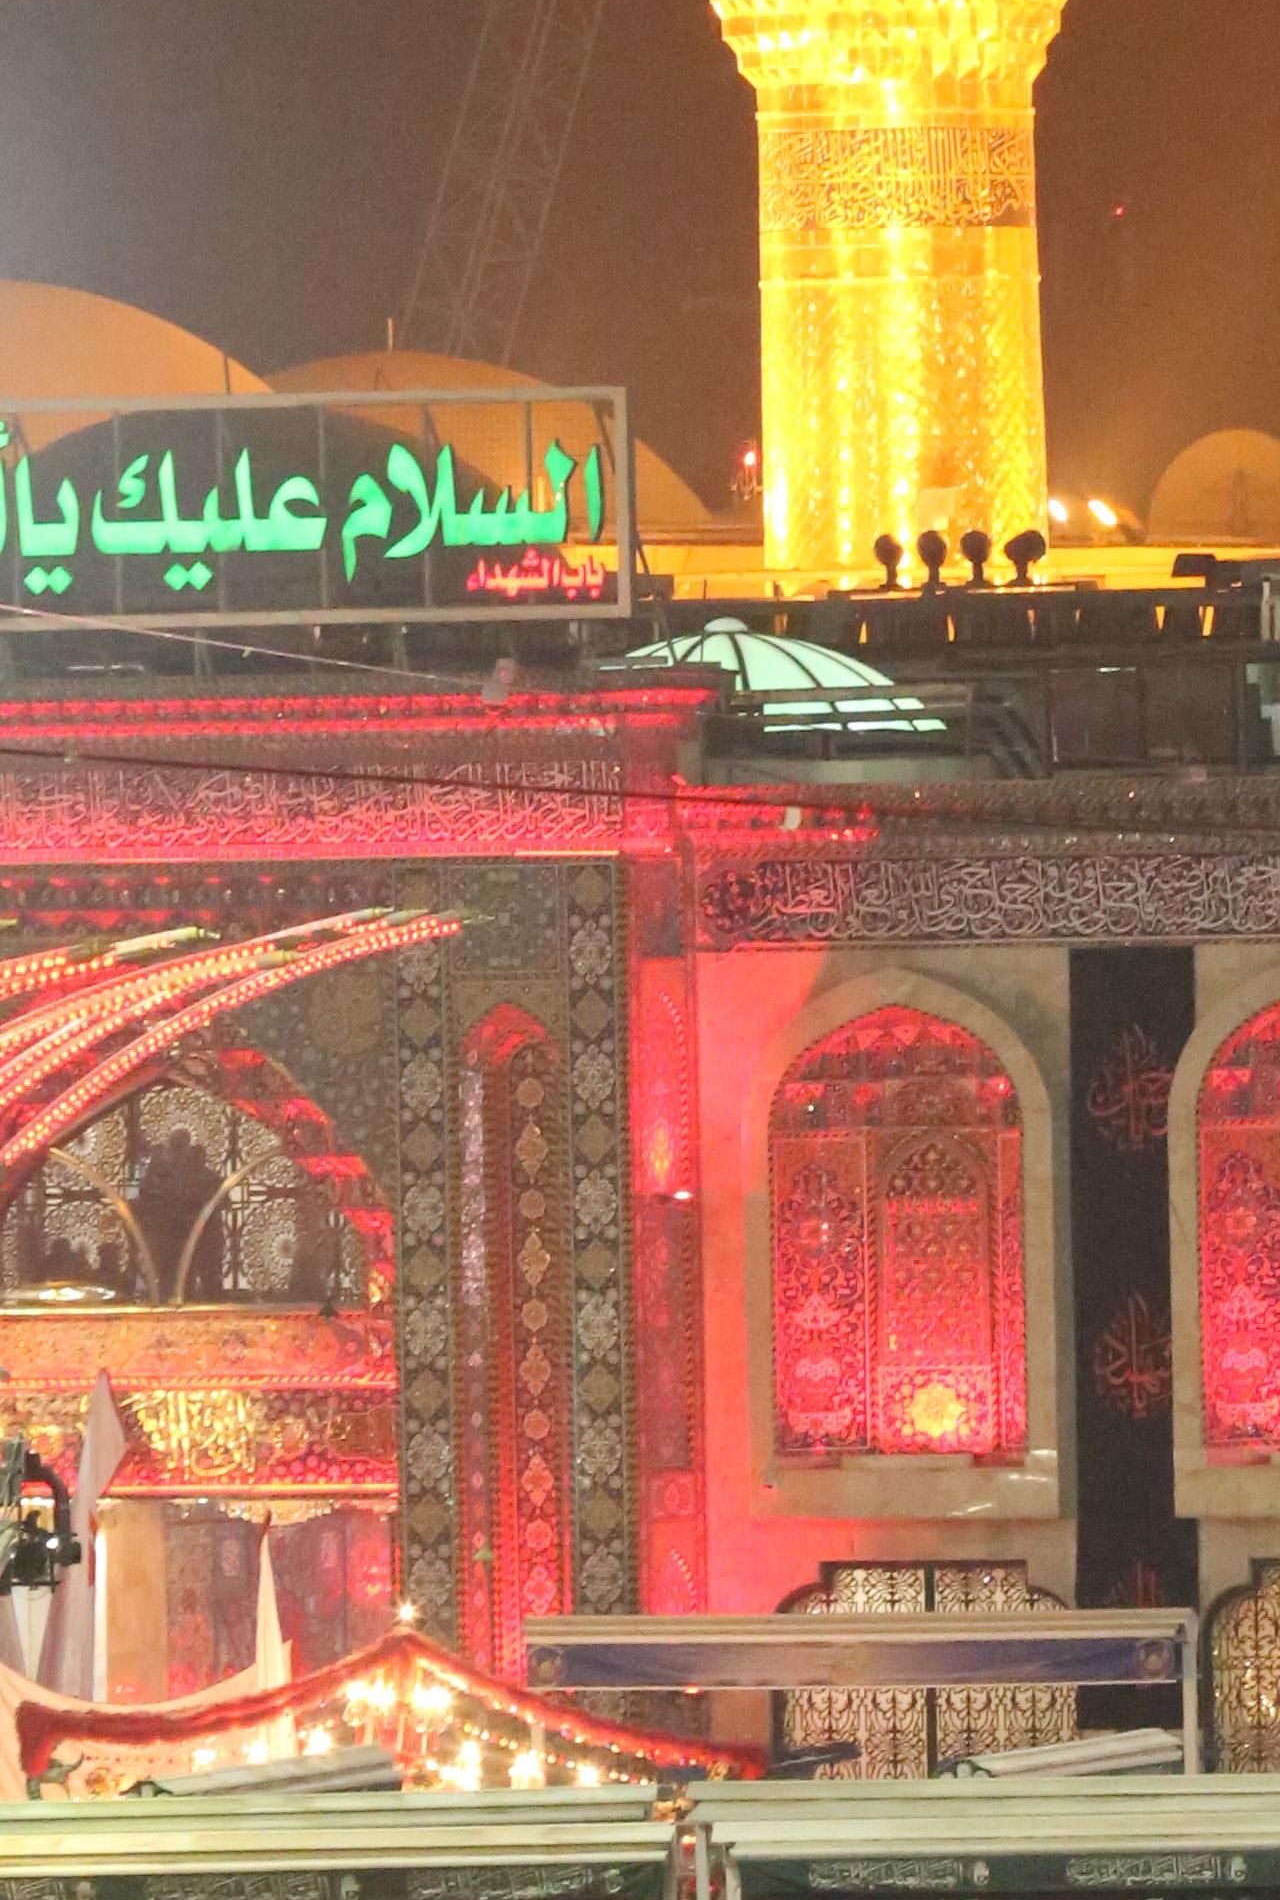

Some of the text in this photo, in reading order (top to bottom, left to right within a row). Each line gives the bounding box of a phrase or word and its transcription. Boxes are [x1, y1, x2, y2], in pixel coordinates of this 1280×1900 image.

[91, 449, 328, 592] عليك
[341, 443, 602, 581] السلام
[466, 545, 606, 600] باب الشهداء
